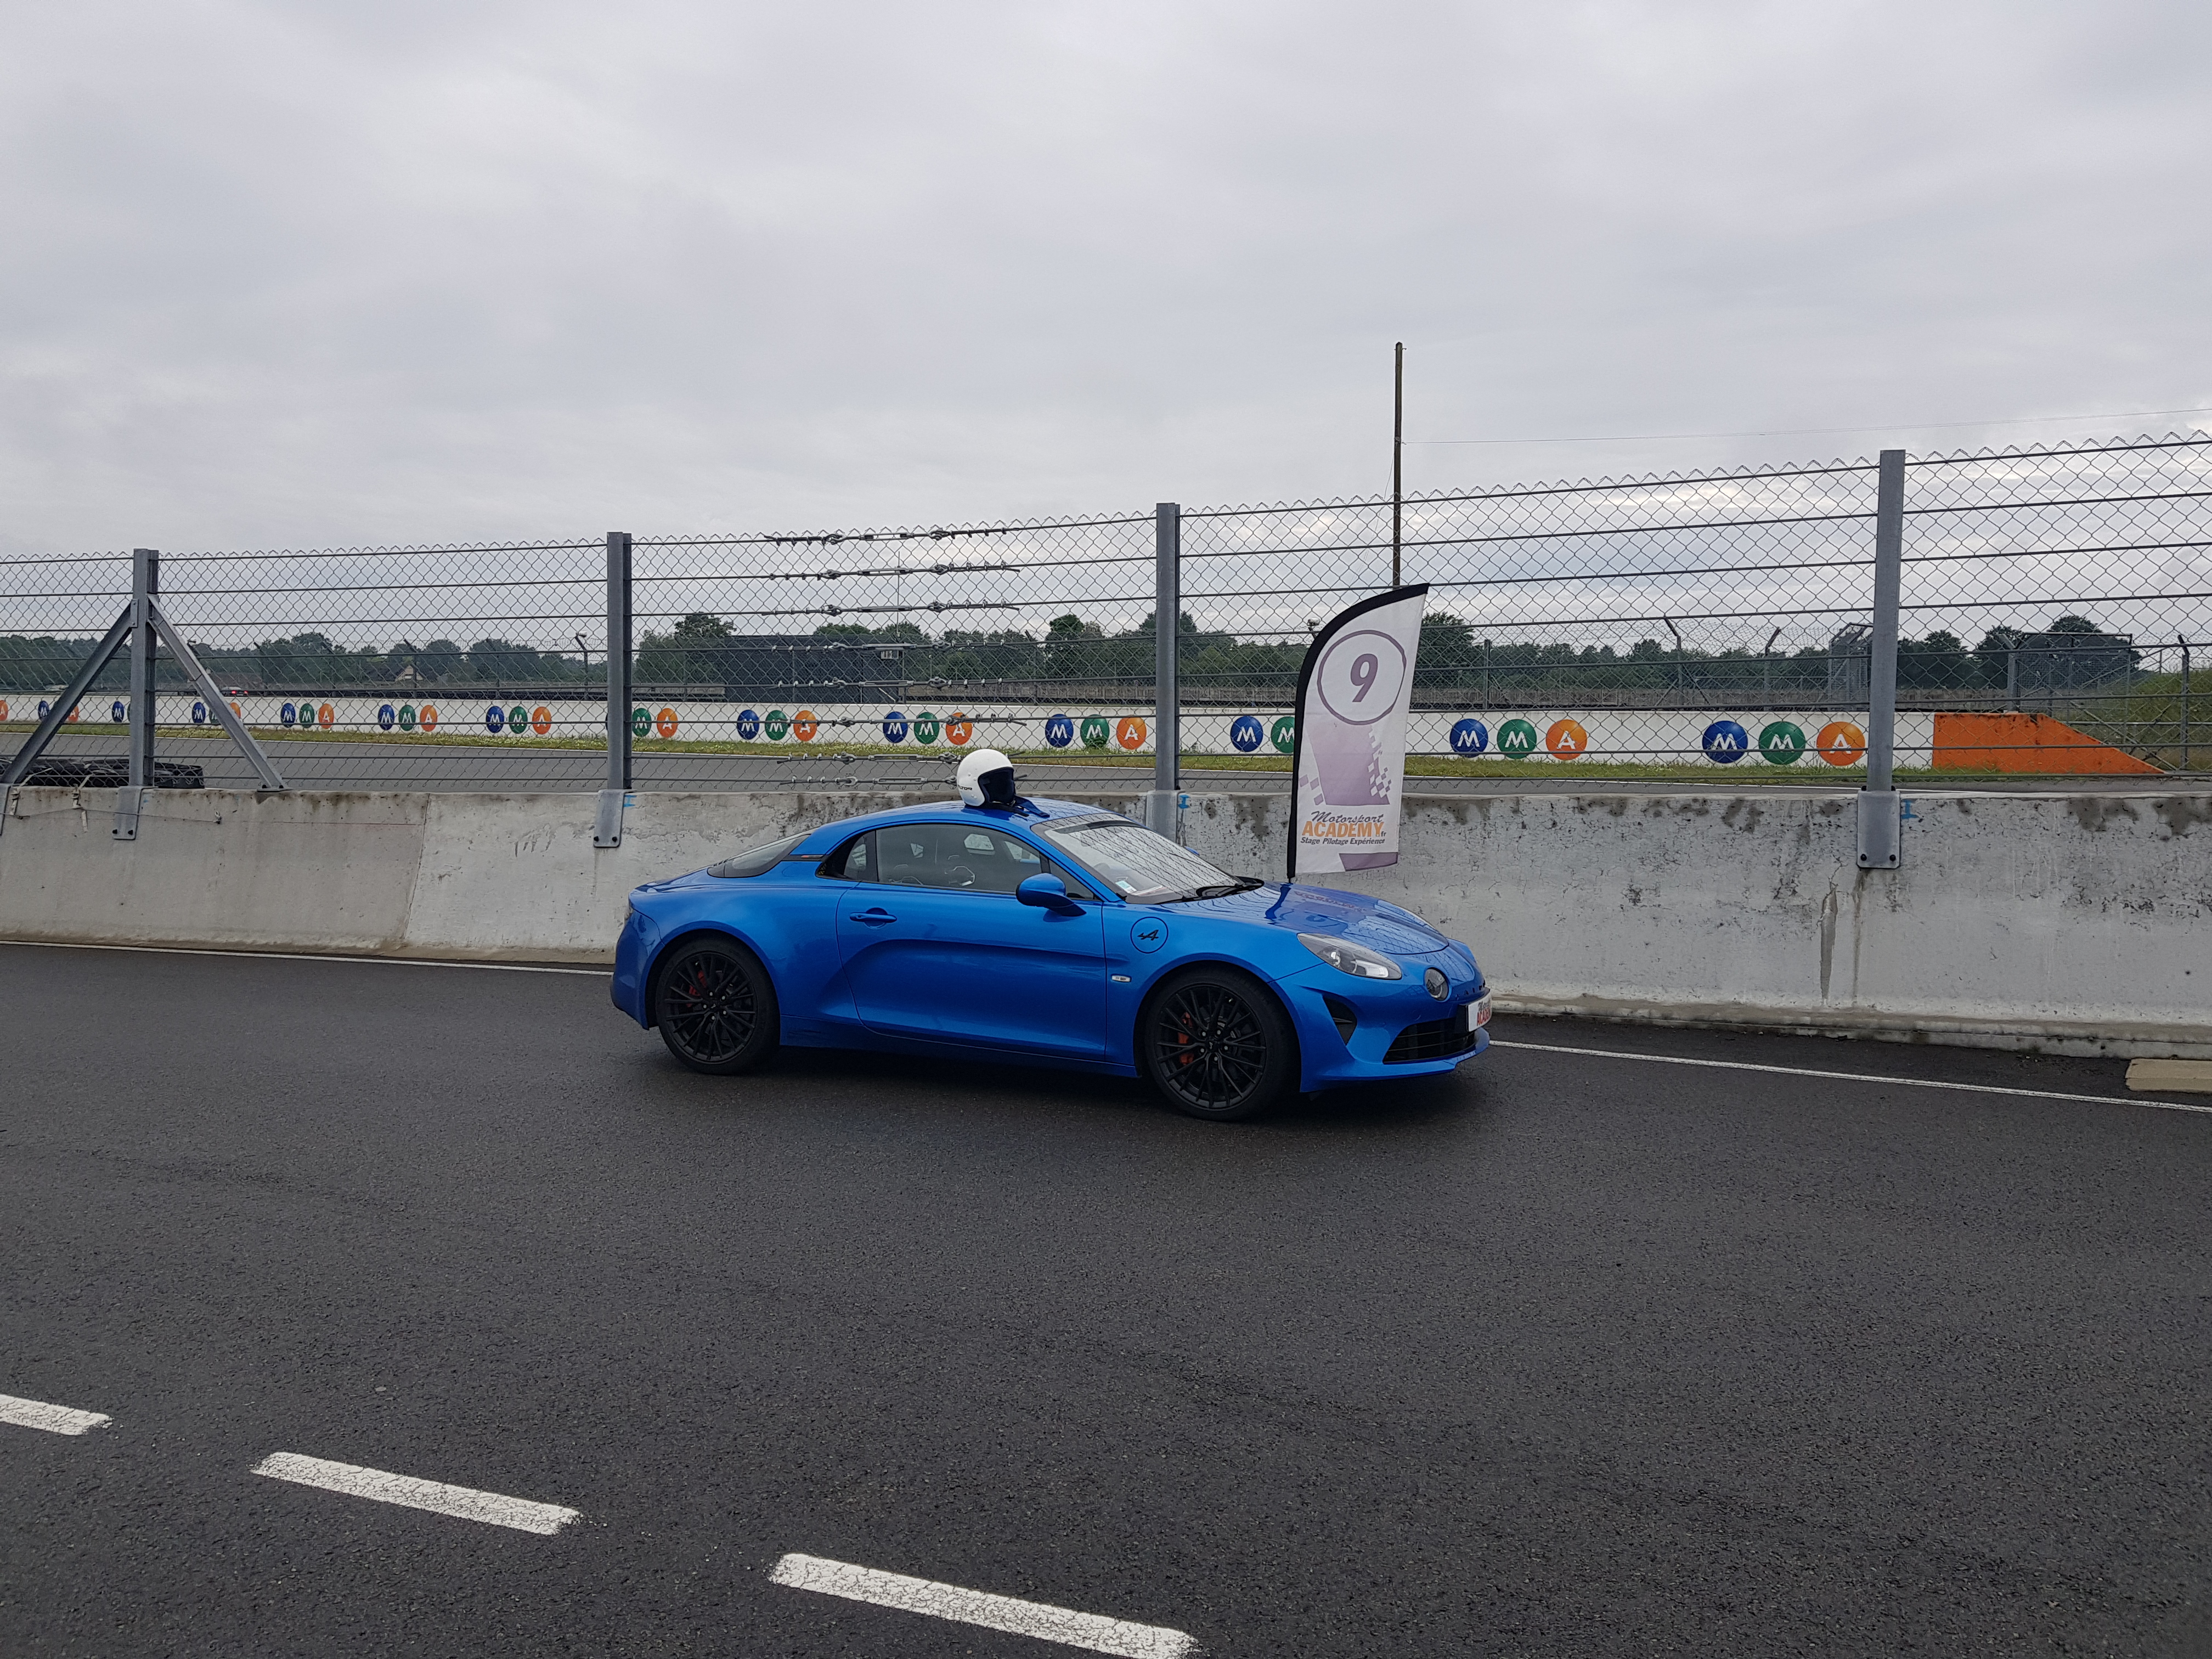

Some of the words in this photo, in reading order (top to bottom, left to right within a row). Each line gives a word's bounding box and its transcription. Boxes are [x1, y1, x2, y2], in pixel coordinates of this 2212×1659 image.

[1350, 653, 1378, 703] 9
[1311, 811, 1384, 825] Motorsport
[1300, 837, 1321, 845] Stage
